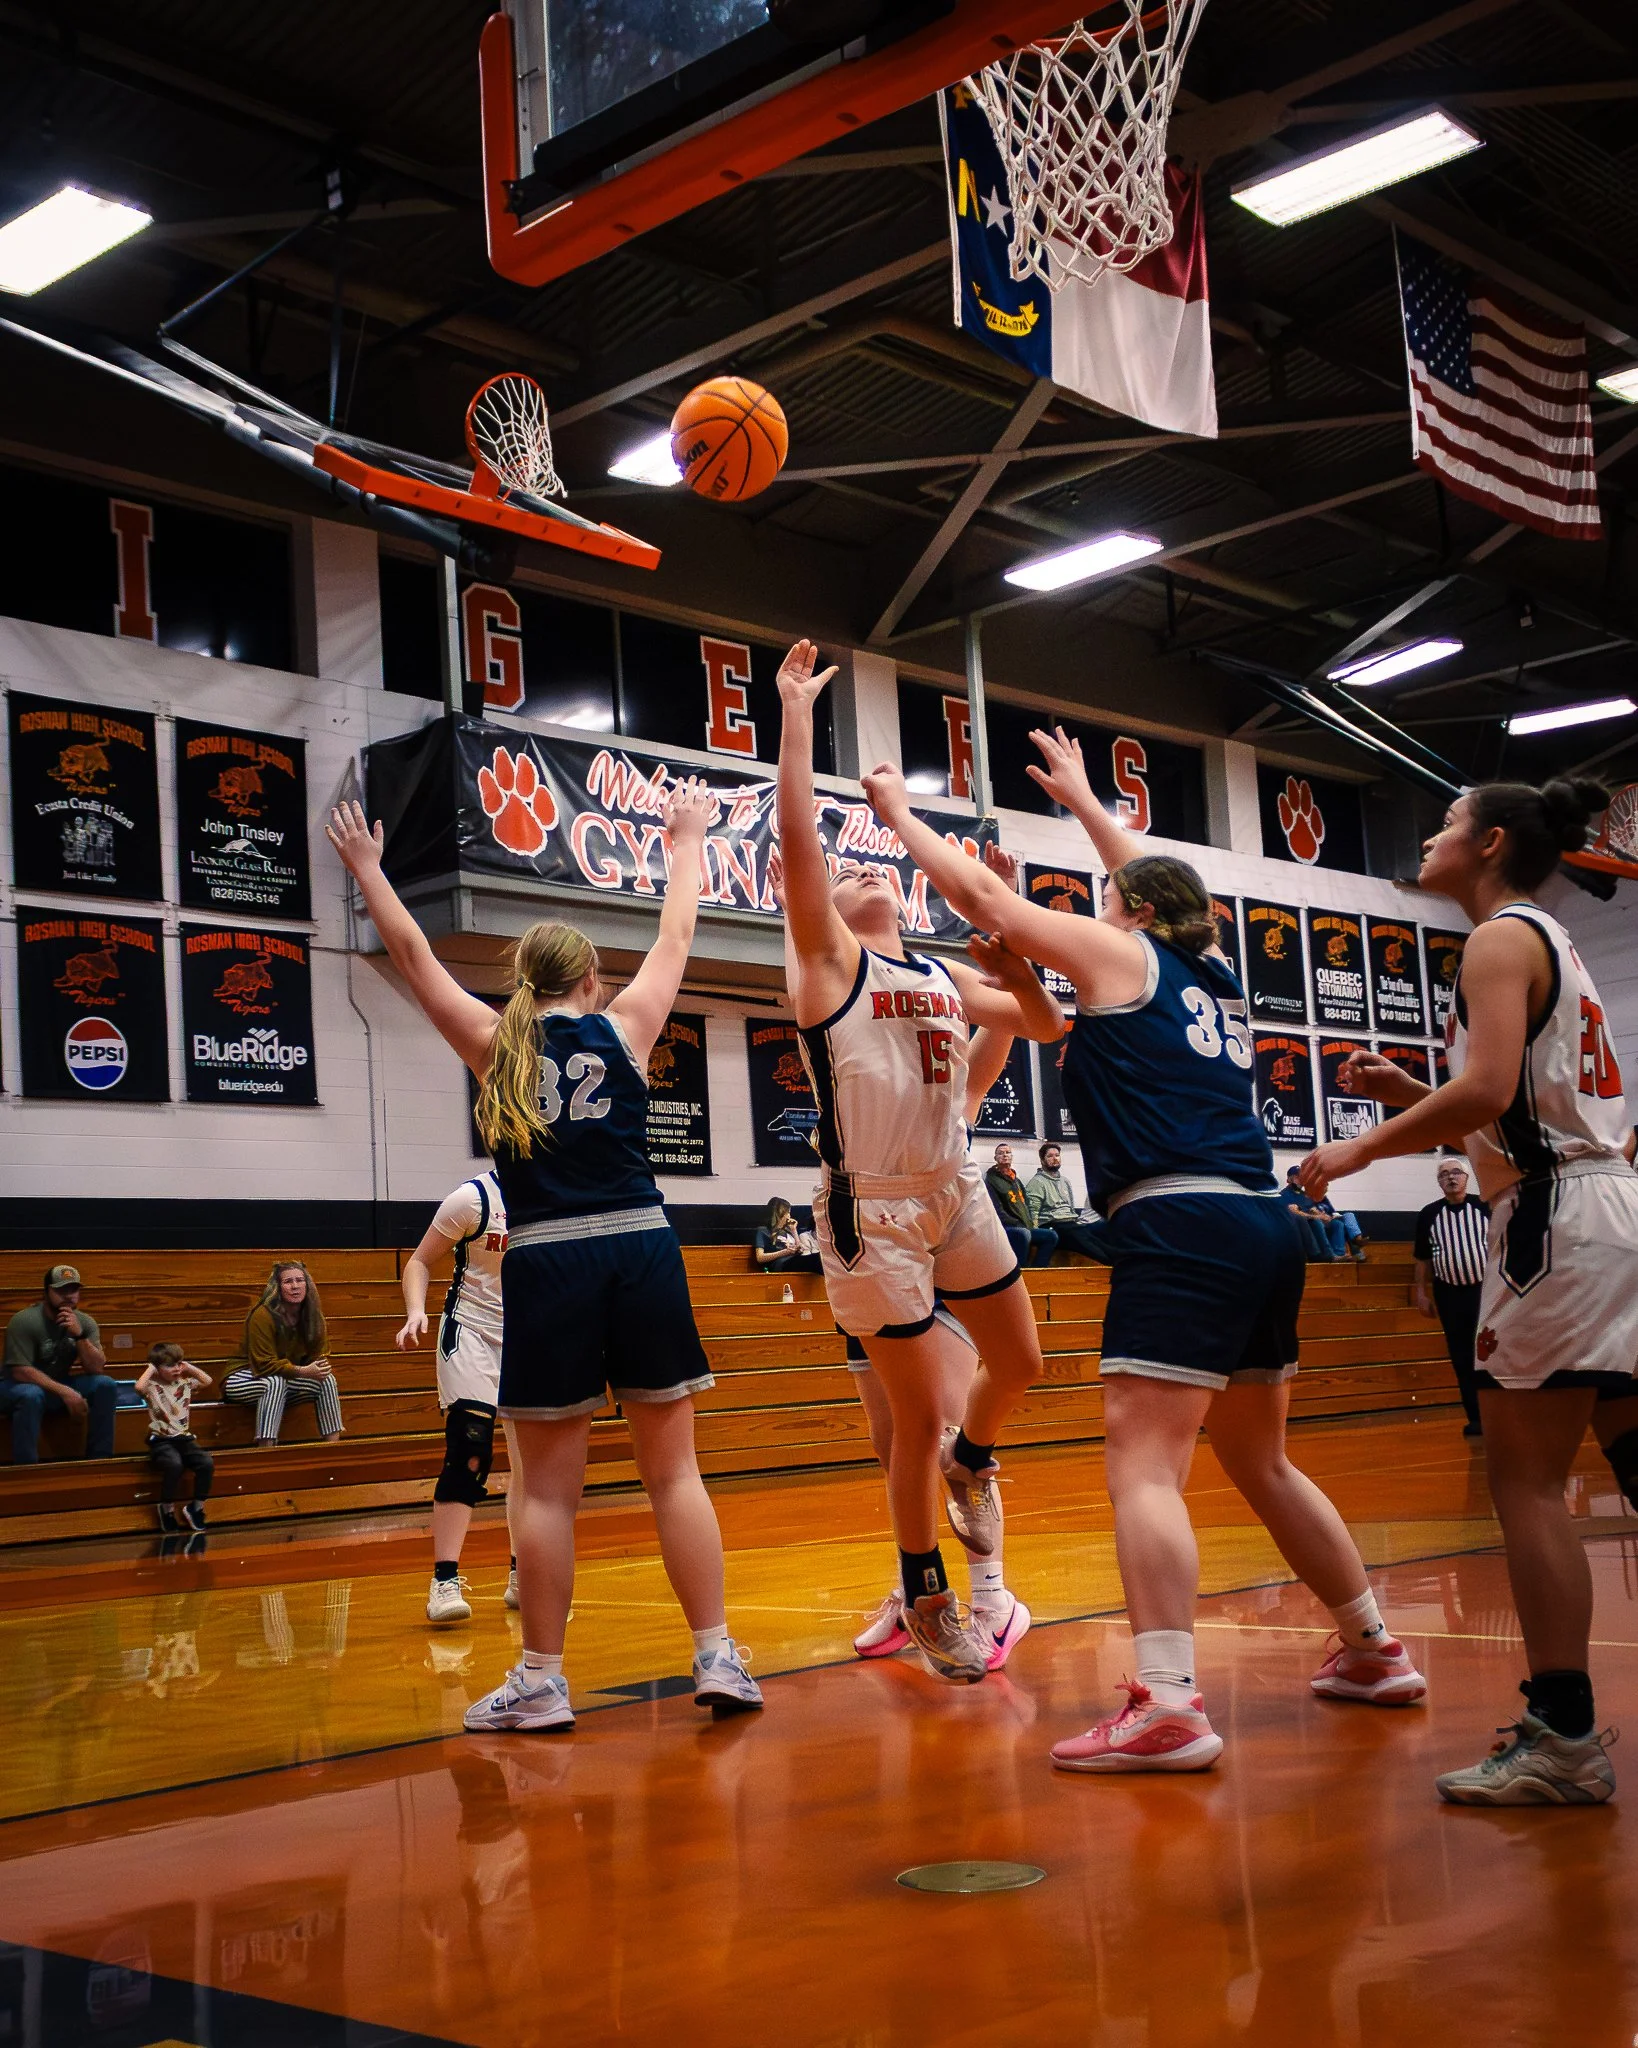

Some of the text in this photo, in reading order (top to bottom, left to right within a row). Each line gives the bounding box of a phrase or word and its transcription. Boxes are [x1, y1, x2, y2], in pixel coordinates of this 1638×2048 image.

[104, 804, 134, 830] Union
[200, 818, 285, 846] John Tinsley
[25, 920, 156, 953] ROSMAN HIGH SCHOOL
[186, 932, 306, 965] ROSMAN HIGH SCHOOL
[1316, 967, 1364, 988] QUEBEC
[869, 990, 968, 1026] ROSMA
[1181, 986, 1252, 1069] 35
[68, 1044, 125, 1062] PEPSI
[193, 1033, 308, 1071] BlueRidge
[917, 1030, 953, 1085] 15
[218, 1078, 284, 1095] blueridge.edu
